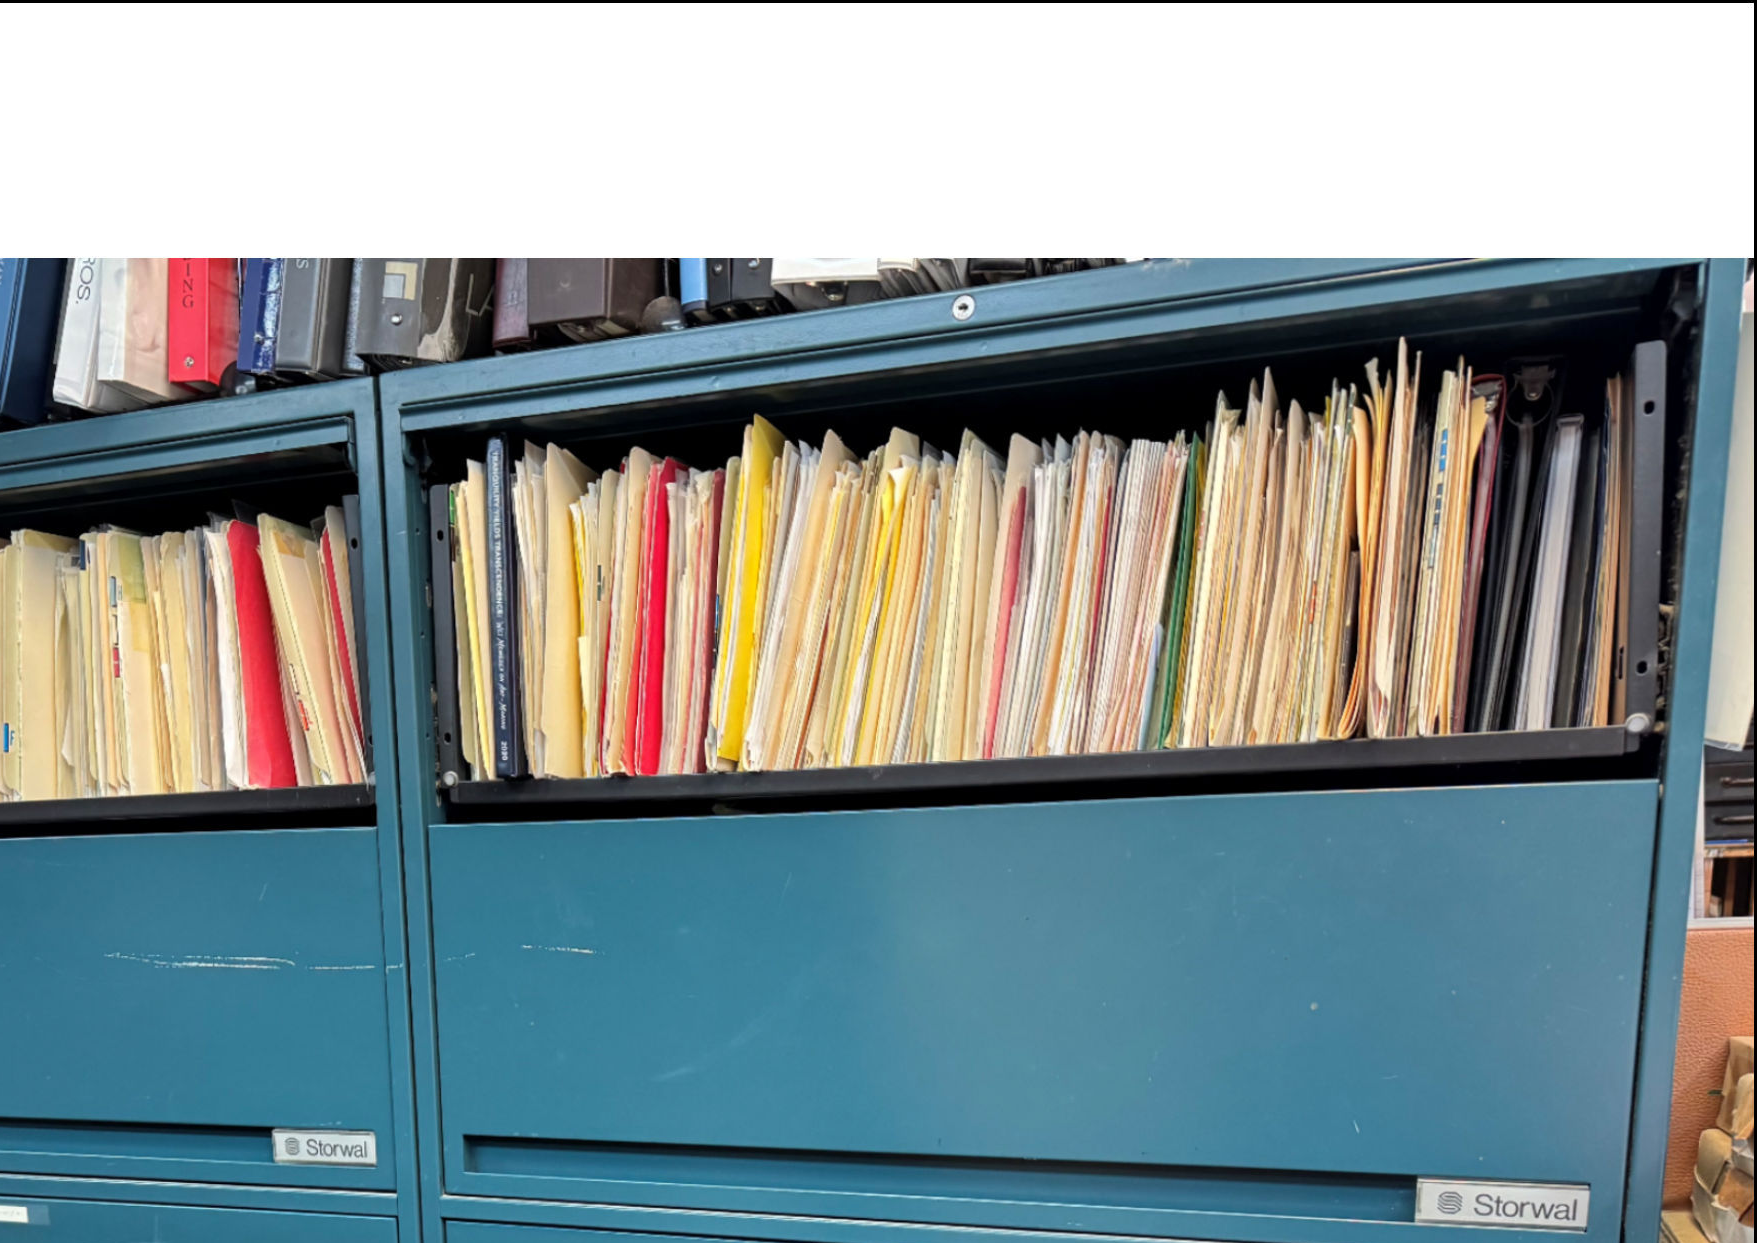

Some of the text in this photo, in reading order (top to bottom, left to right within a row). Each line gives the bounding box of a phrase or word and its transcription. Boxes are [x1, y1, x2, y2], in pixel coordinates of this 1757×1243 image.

[181, 258, 194, 309] ING
[305, 1138, 369, 1159] Storwal
[1473, 1193, 1578, 1221] Storwal
